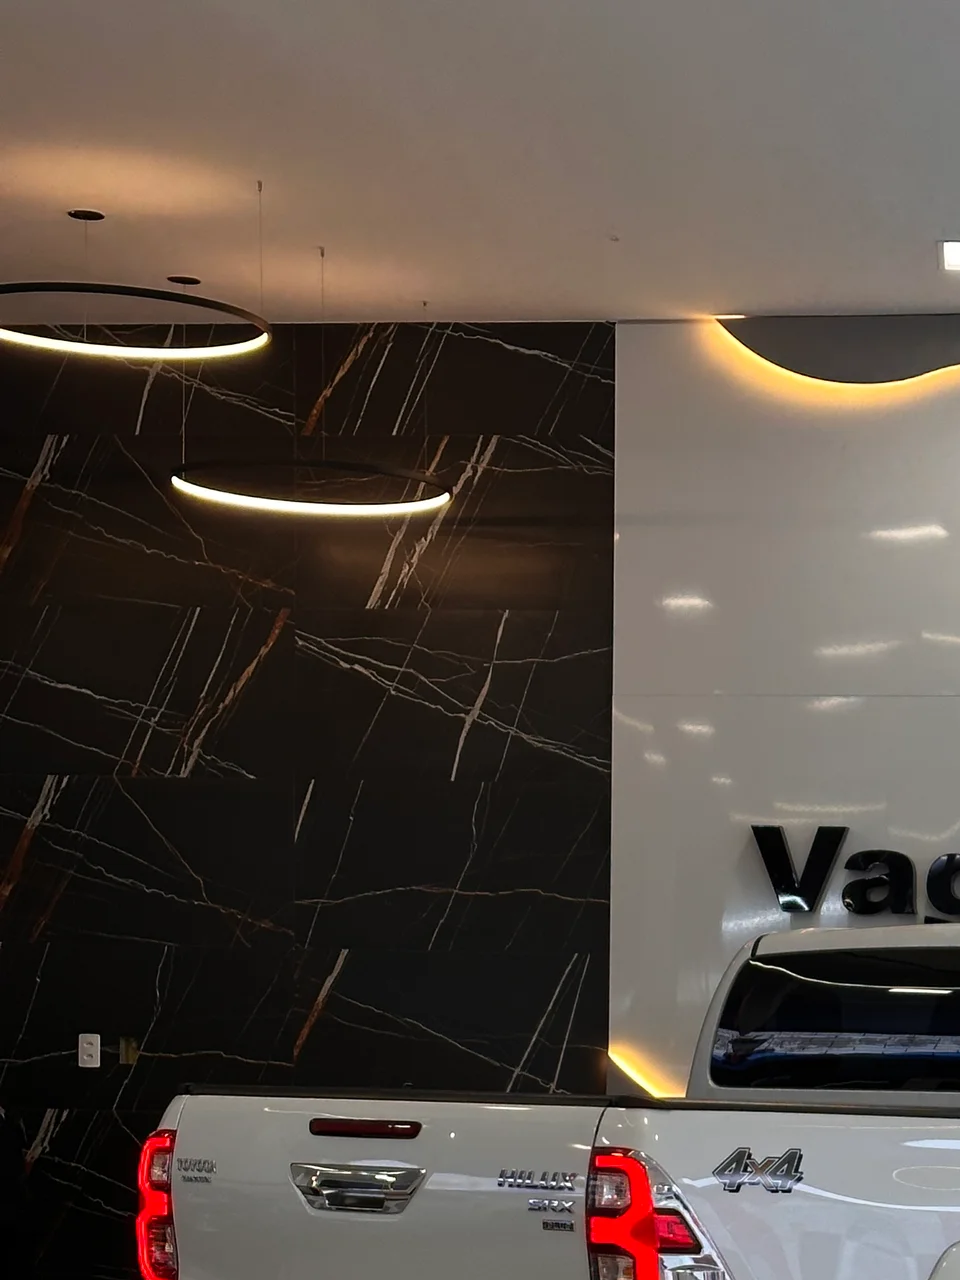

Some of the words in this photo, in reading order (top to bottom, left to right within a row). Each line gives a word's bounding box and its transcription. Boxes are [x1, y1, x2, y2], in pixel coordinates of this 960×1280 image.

[177, 1157, 216, 1174] TOYOTA
[498, 1168, 578, 1191] HILUX
[528, 1198, 574, 1213] SRX
